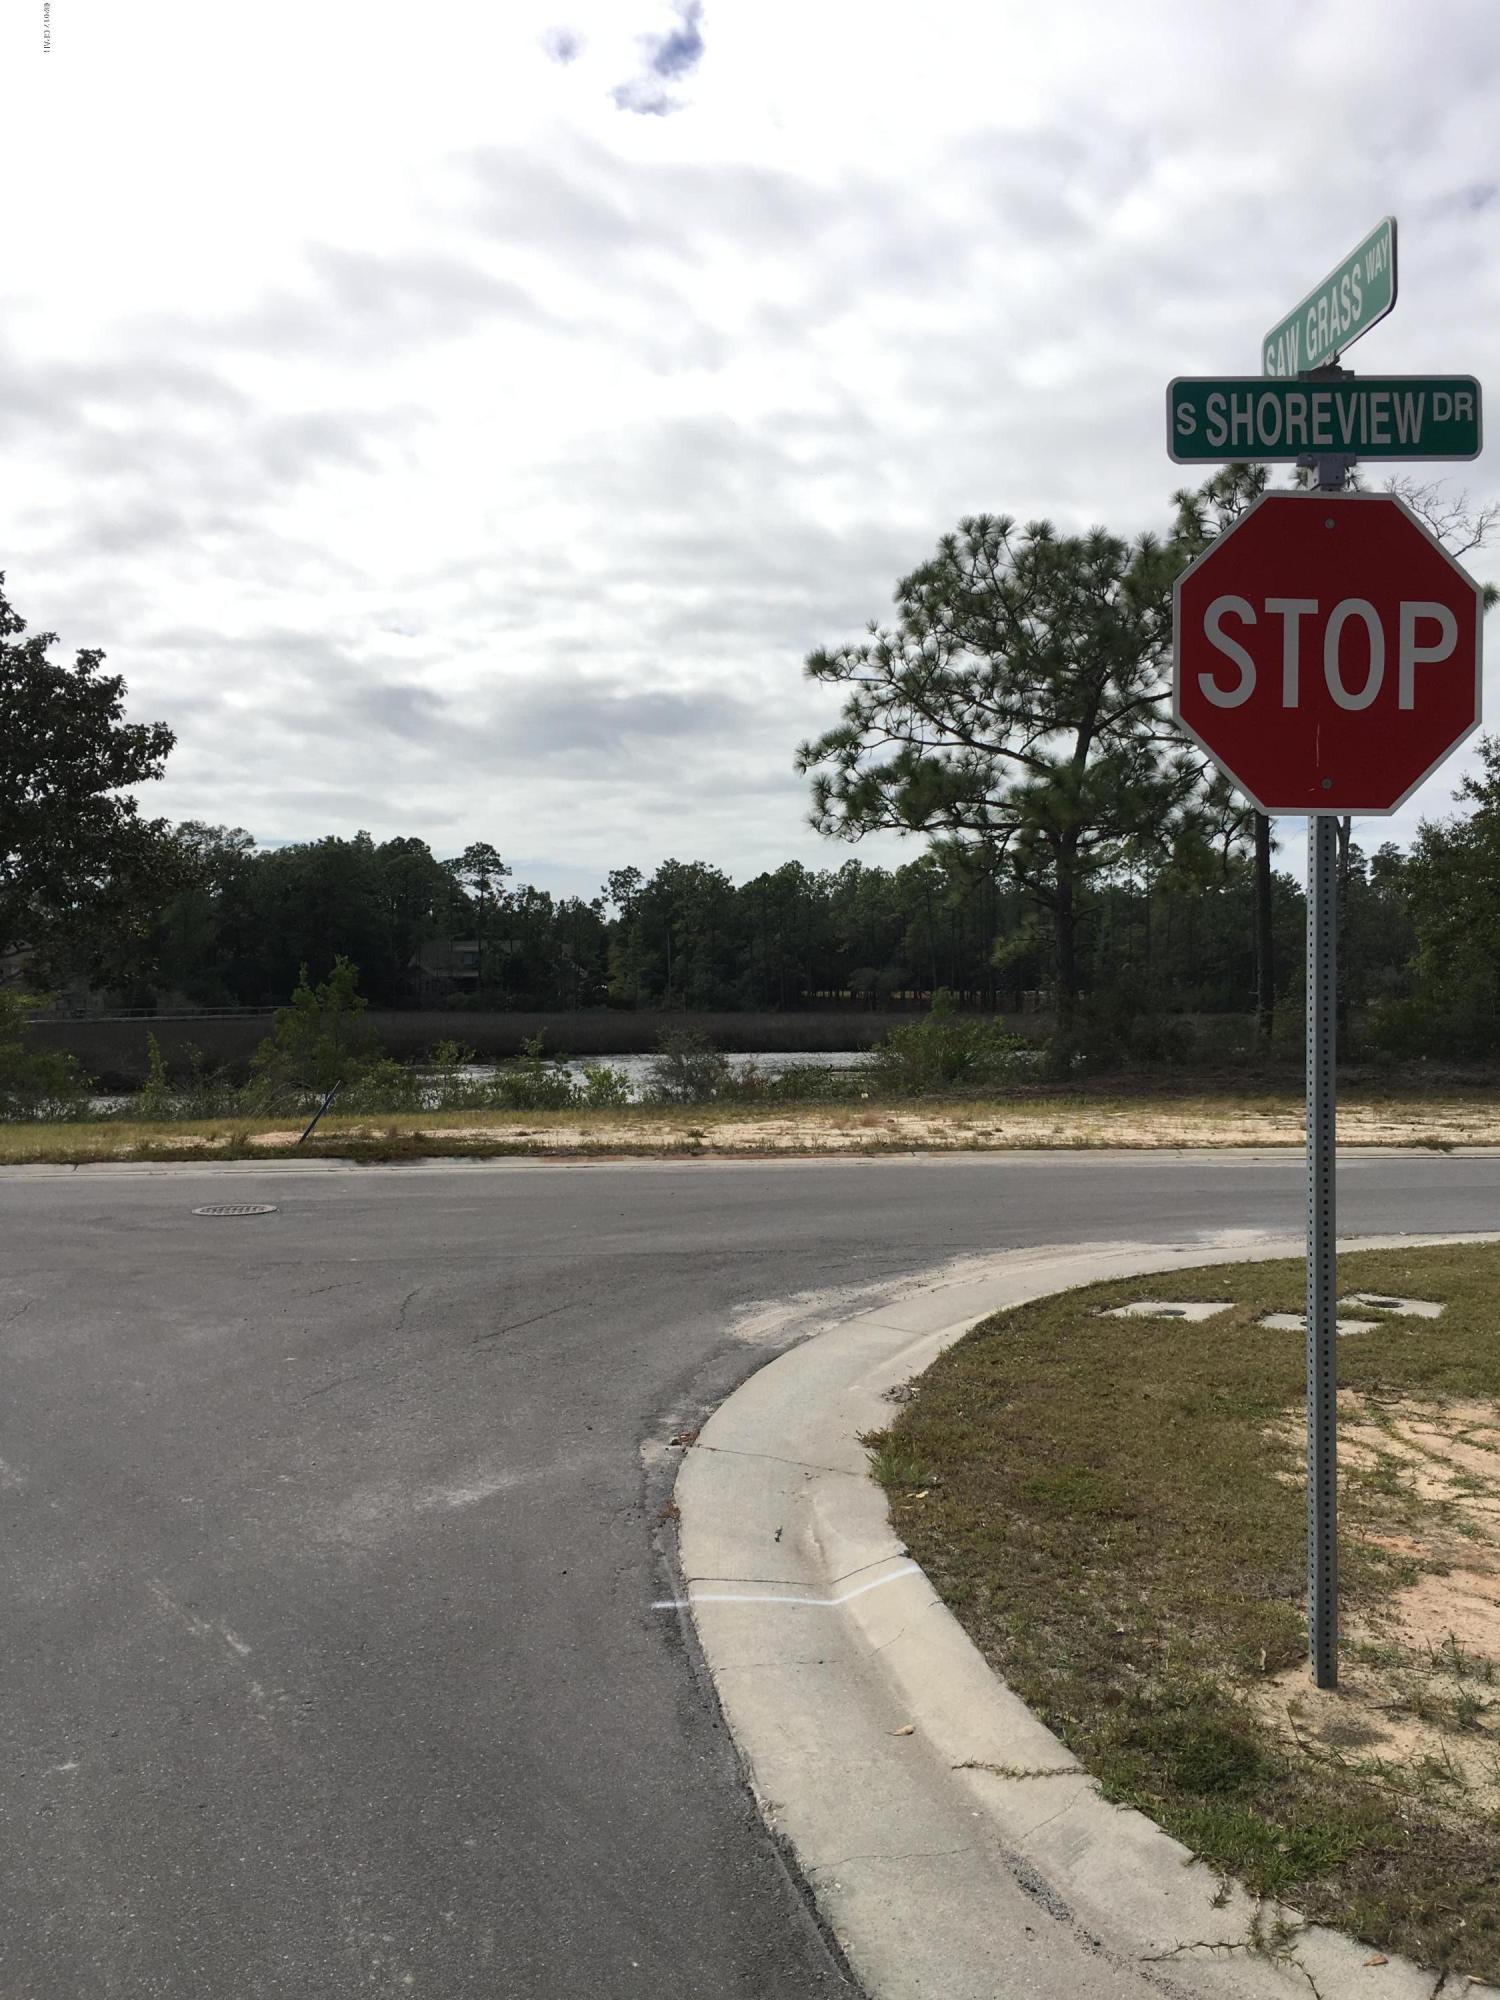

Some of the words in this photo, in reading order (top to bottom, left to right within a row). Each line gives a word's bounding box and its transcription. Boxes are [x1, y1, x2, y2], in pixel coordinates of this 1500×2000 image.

[1306, 264, 1362, 361] GRASS
[1365, 234, 1389, 284] WAY
[1176, 402, 1197, 435] S
[1206, 392, 1425, 447] SHOREVIEW
[1433, 392, 1473, 422] DR
[1198, 595, 1458, 711] STOP
